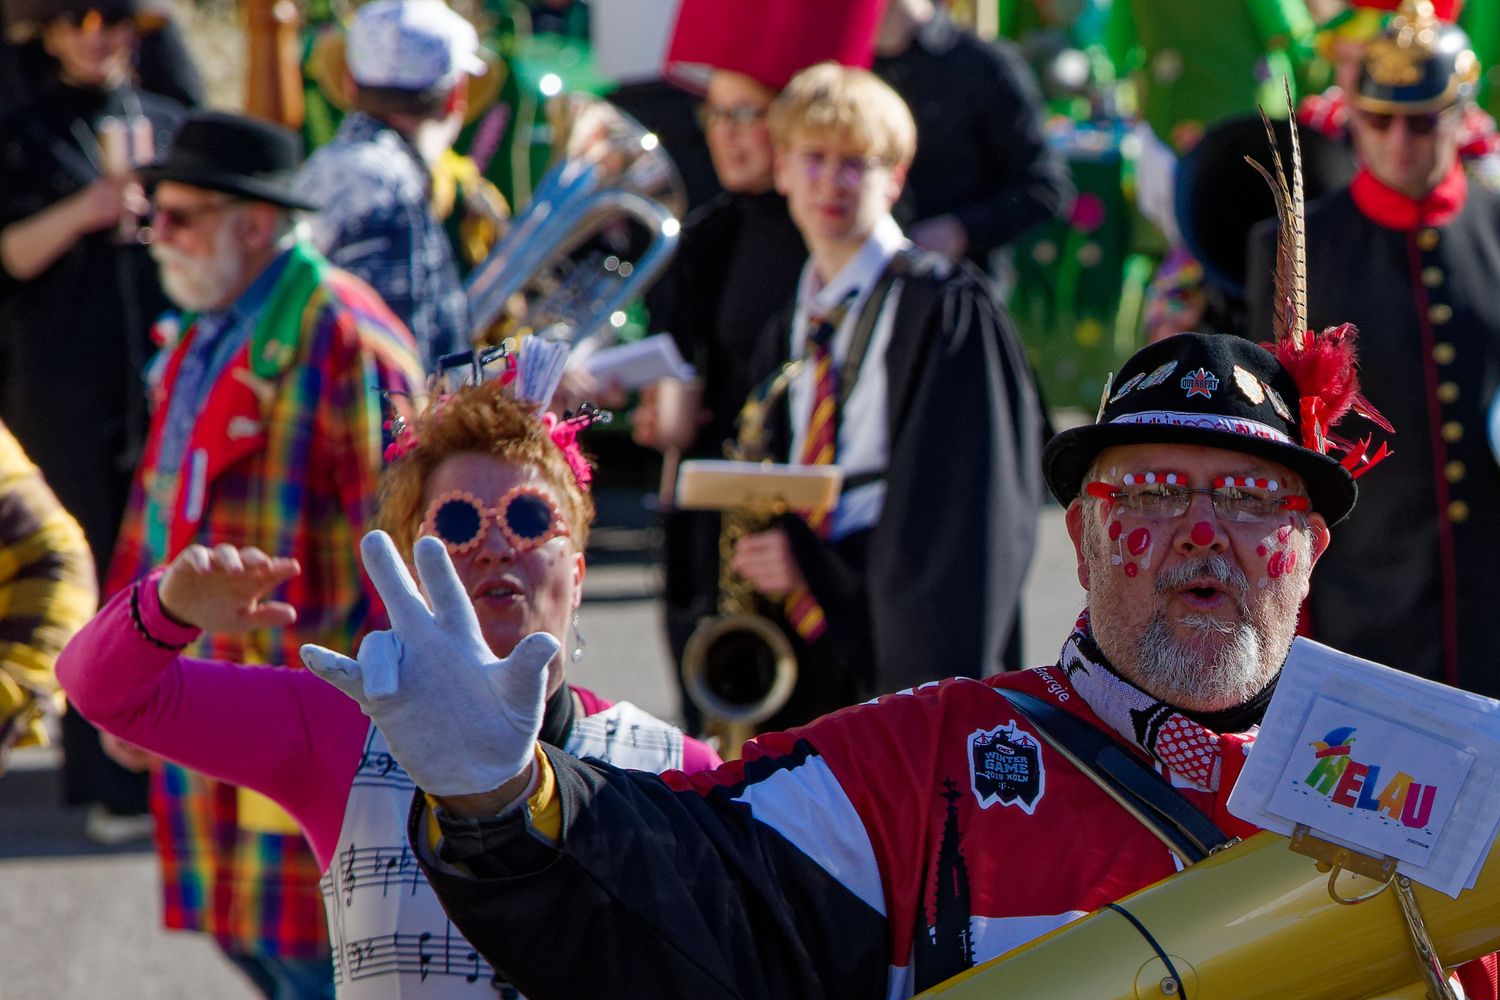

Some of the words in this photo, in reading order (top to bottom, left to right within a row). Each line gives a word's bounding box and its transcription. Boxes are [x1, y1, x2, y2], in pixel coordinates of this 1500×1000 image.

[985, 752, 1027, 764] WINTER
[985, 759, 1028, 774] GAME
[1304, 754, 1437, 829] HELAU
